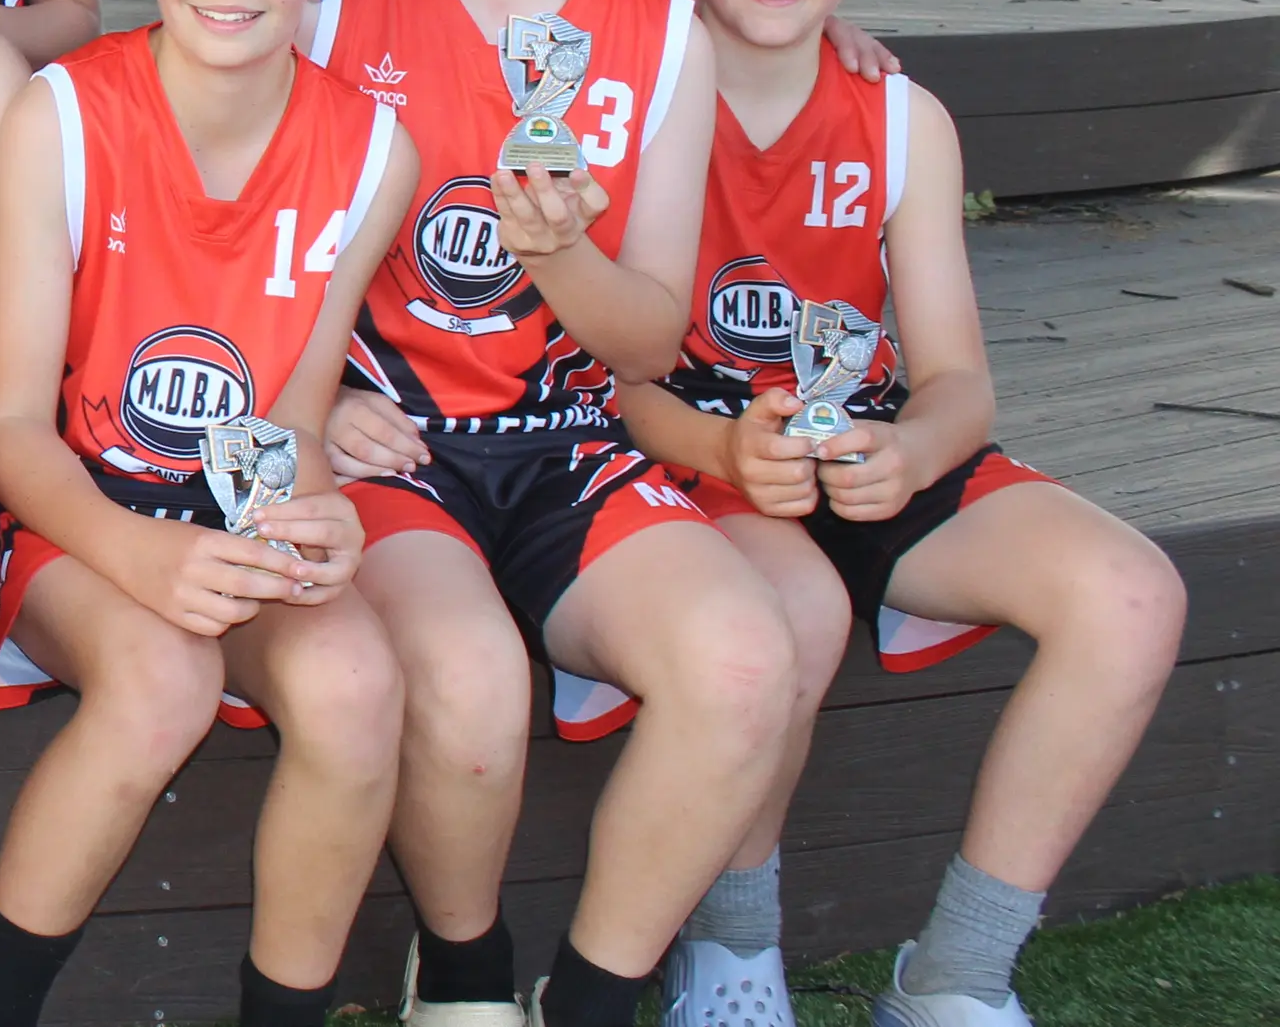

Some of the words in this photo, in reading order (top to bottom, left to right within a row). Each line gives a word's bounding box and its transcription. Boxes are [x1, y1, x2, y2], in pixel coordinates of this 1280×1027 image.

[804, 161, 872, 228] 12
[265, 209, 348, 298] 14
[137, 367, 231, 419] M.D.B.A
[145, 465, 192, 483] SAINT
